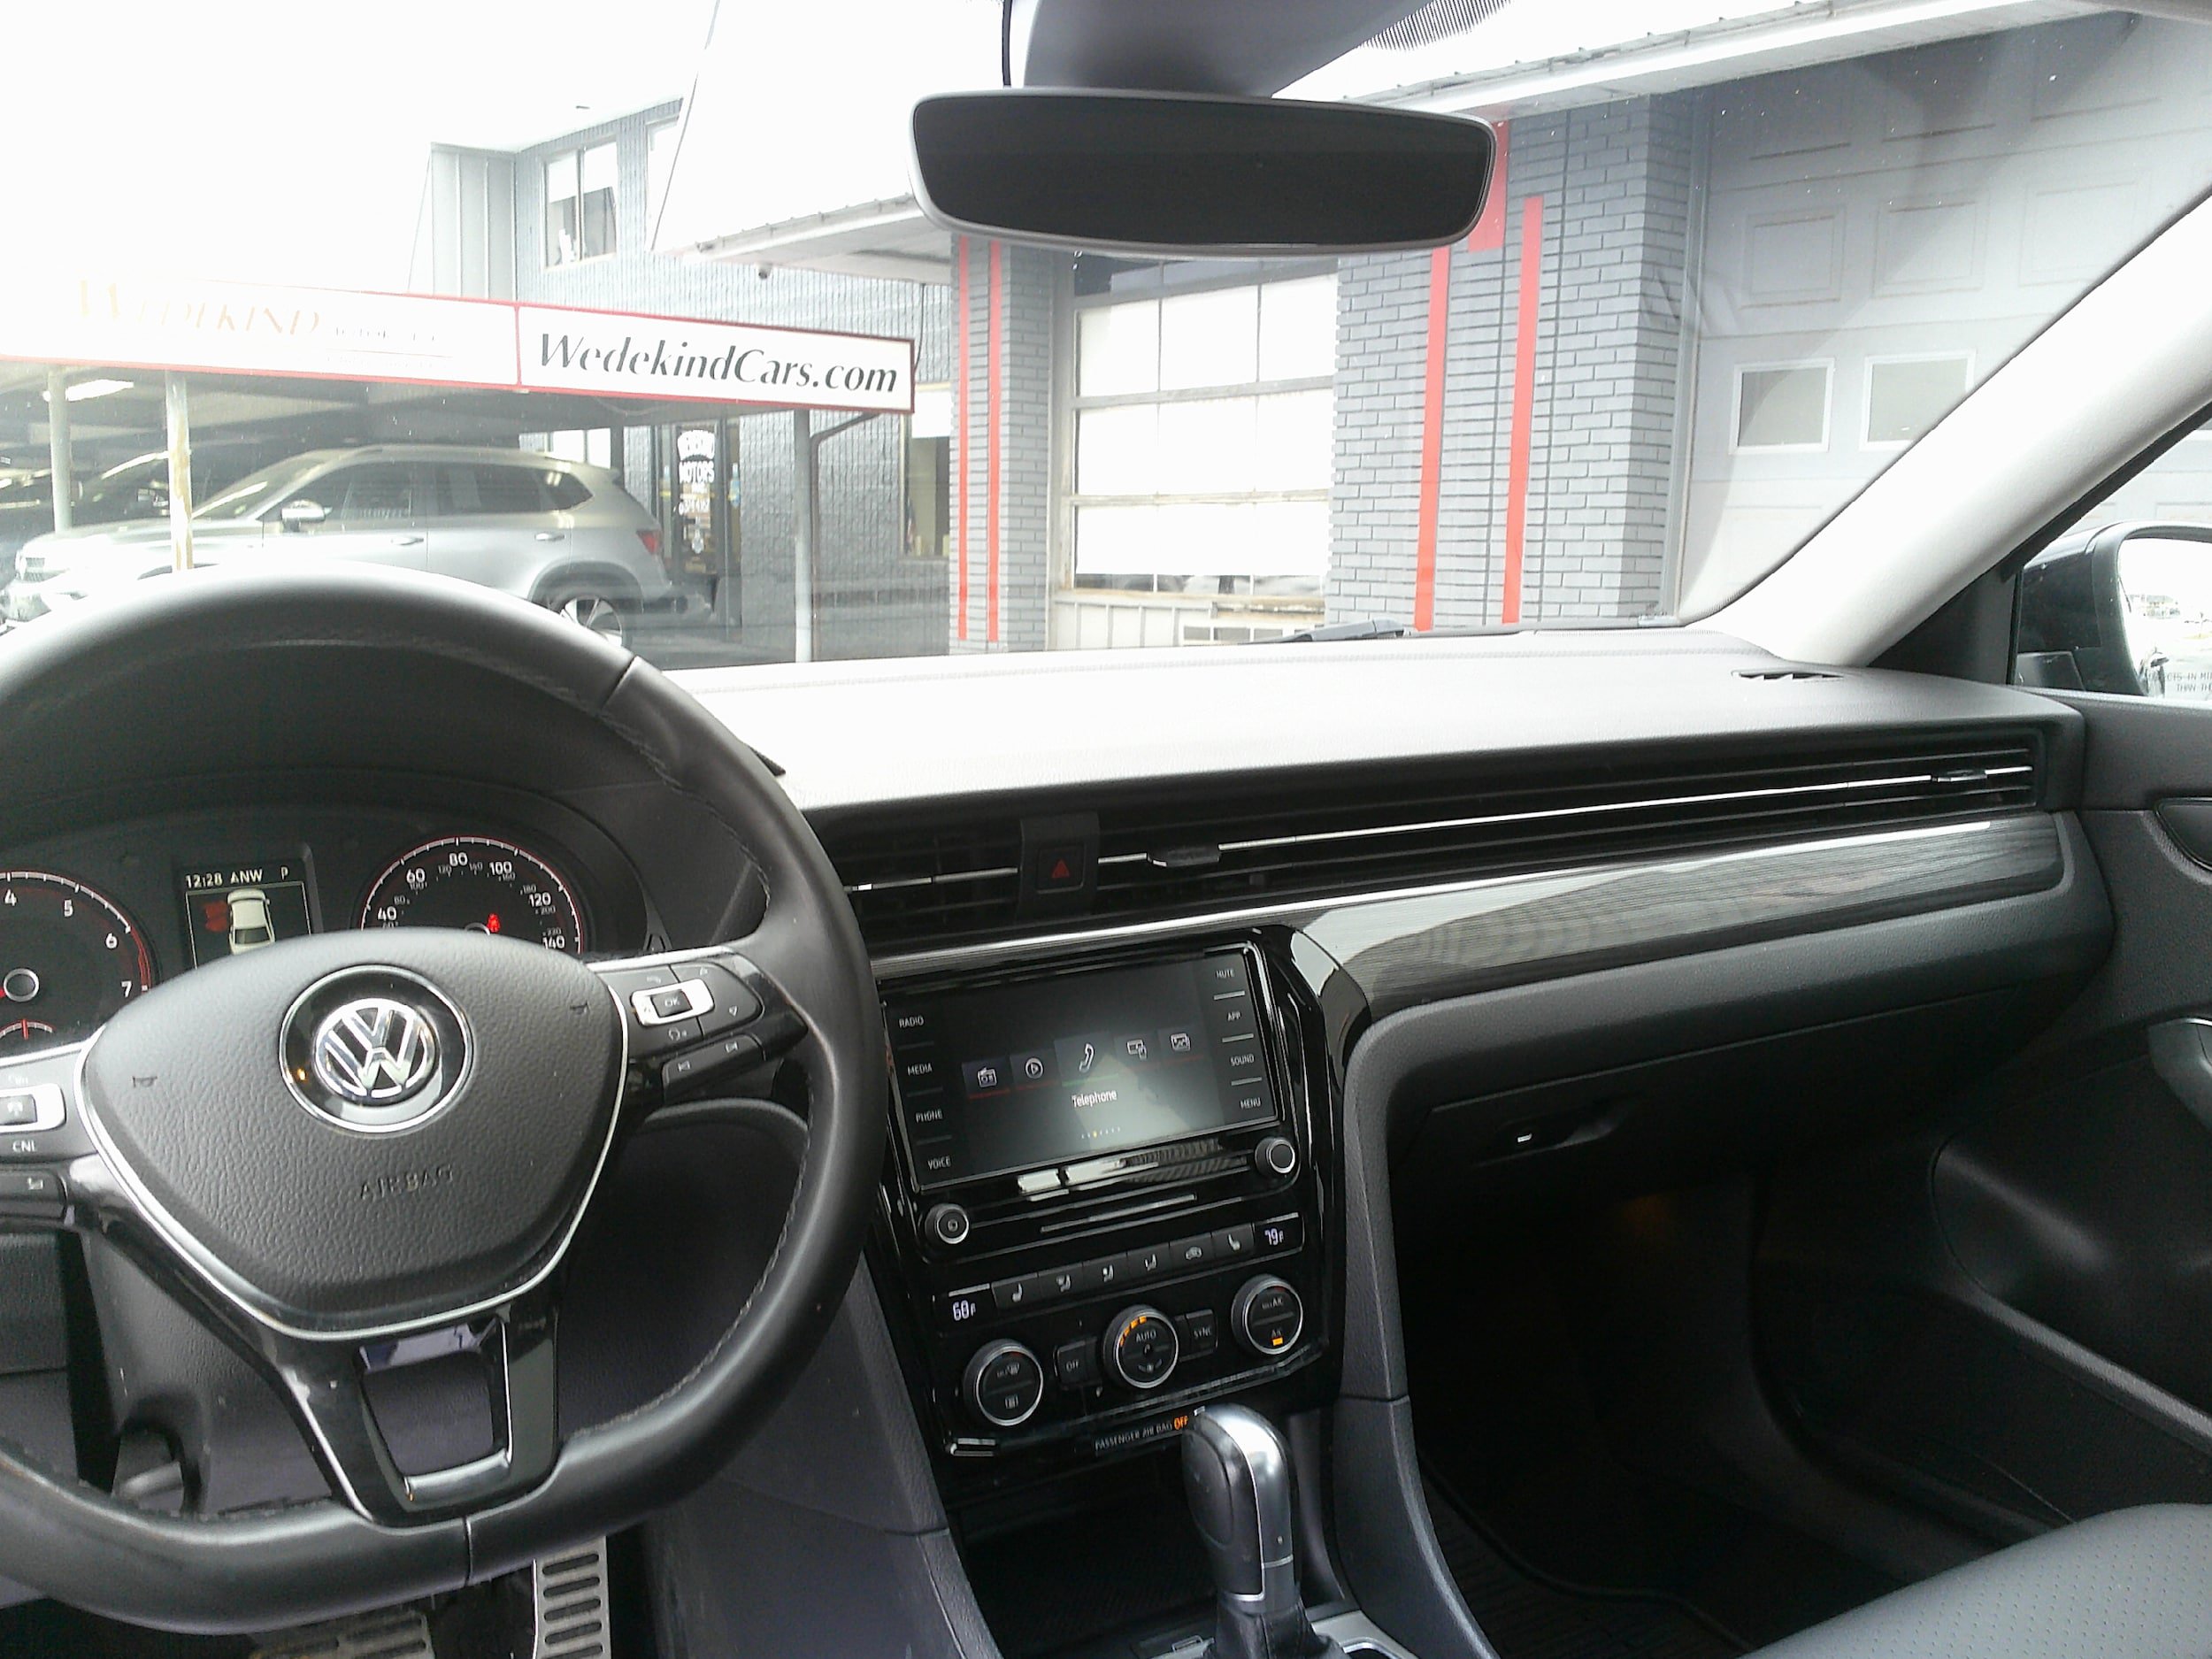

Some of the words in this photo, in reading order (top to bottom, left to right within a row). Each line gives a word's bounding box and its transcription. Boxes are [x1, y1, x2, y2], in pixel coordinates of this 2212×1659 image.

[540, 331, 898, 393] WedekindCars.com
[678, 460, 715, 485] MOTORS
[449, 852, 468, 866] 80
[406, 868, 426, 883] 60
[488, 861, 512, 875] 100
[185, 872, 223, 888] 12:28
[280, 866, 288, 880] P
[4, 890, 17, 907] 4
[530, 892, 552, 907] 120
[63, 901, 73, 917] 5
[378, 907, 397, 921] 40
[105, 933, 118, 949] 6
[542, 935, 565, 949] 140
[121, 980, 133, 998] 7
[664, 996, 680, 1008] OK
[899, 1015, 924, 1029] RADIO
[1227, 1010, 1241, 1022] APP
[1230, 1053, 1255, 1067] SOUND
[907, 1062, 933, 1077] MEDIA
[1071, 1087, 1118, 1109] Telephone
[1240, 1096, 1262, 1110] MENU
[916, 1109, 943, 1124] PHONE
[12, 1139, 36, 1153] CNL
[927, 1156, 951, 1171] VOICE
[360, 1164, 453, 1201] AIRBAG
[1135, 1329, 1157, 1343] AUTO
[1094, 1430, 1141, 1451] PASSENGER
[1142, 1425, 1155, 1439] AIR
[1172, 1415, 1189, 1431] OFF
